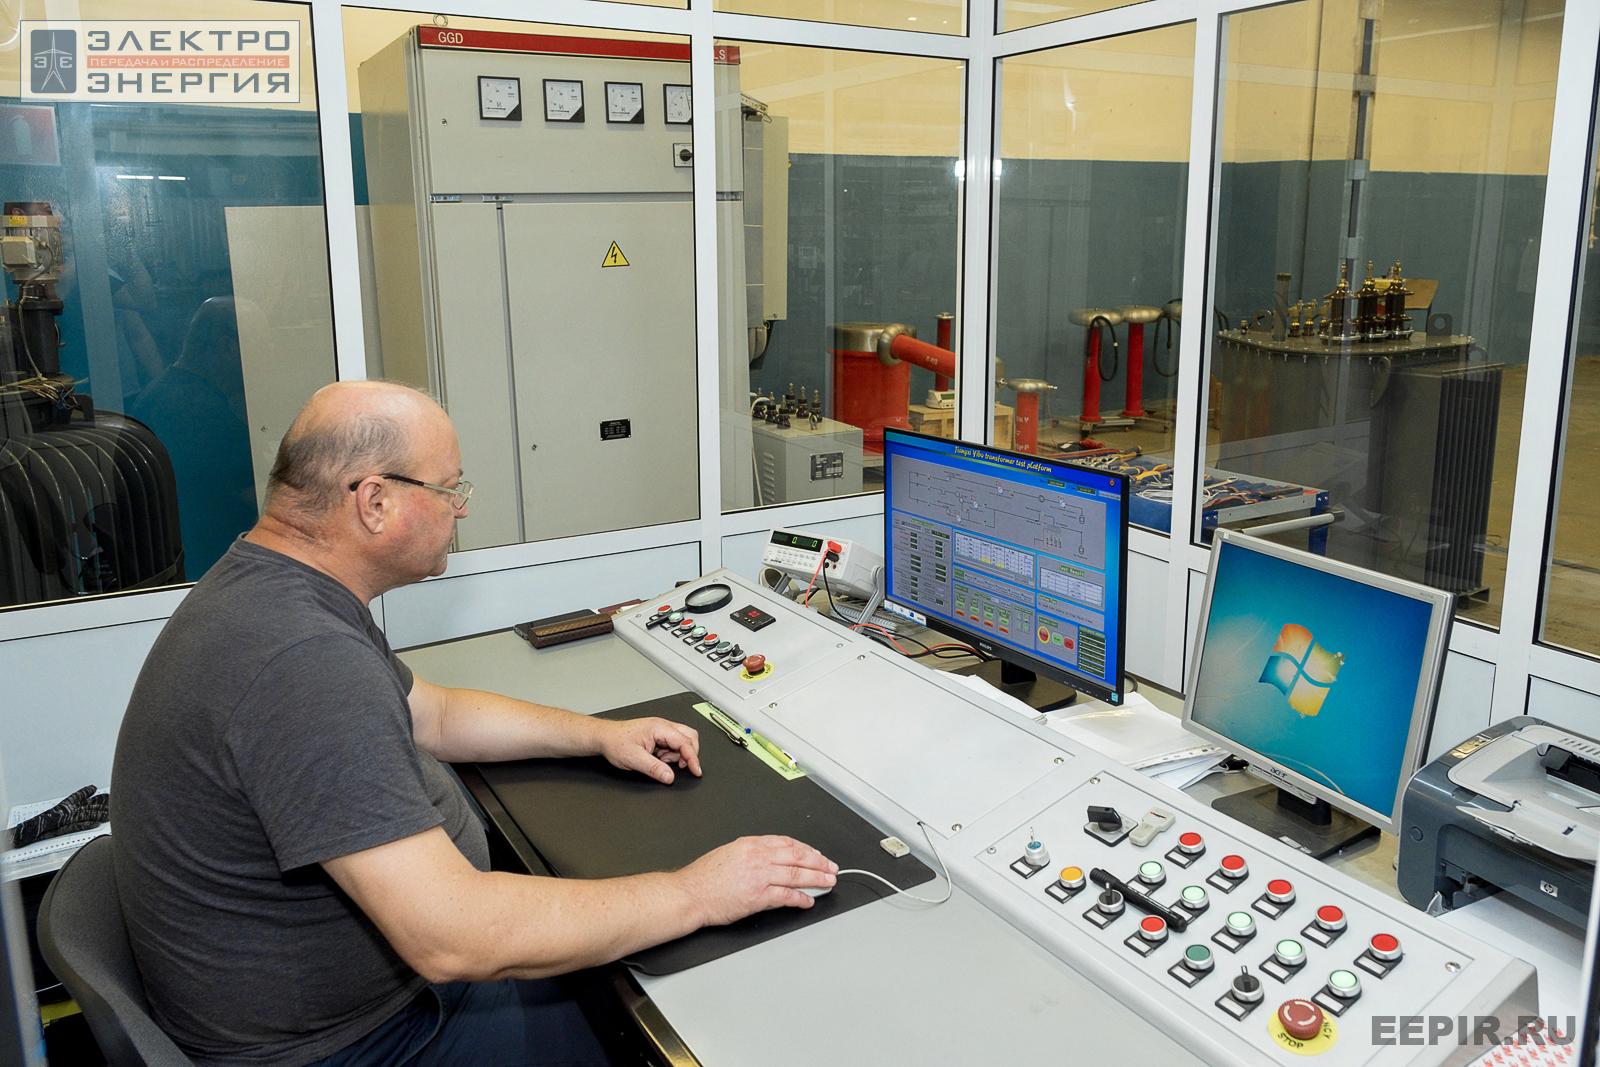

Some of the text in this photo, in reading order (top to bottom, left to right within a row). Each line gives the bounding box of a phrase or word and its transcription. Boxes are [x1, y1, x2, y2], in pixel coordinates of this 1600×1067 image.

[438, 31, 464, 44] GGD
[985, 453, 1015, 465] transformer
[1016, 459, 1026, 468] test
[1026, 461, 1052, 473] platform
[1277, 1032, 1304, 1048] STOP
